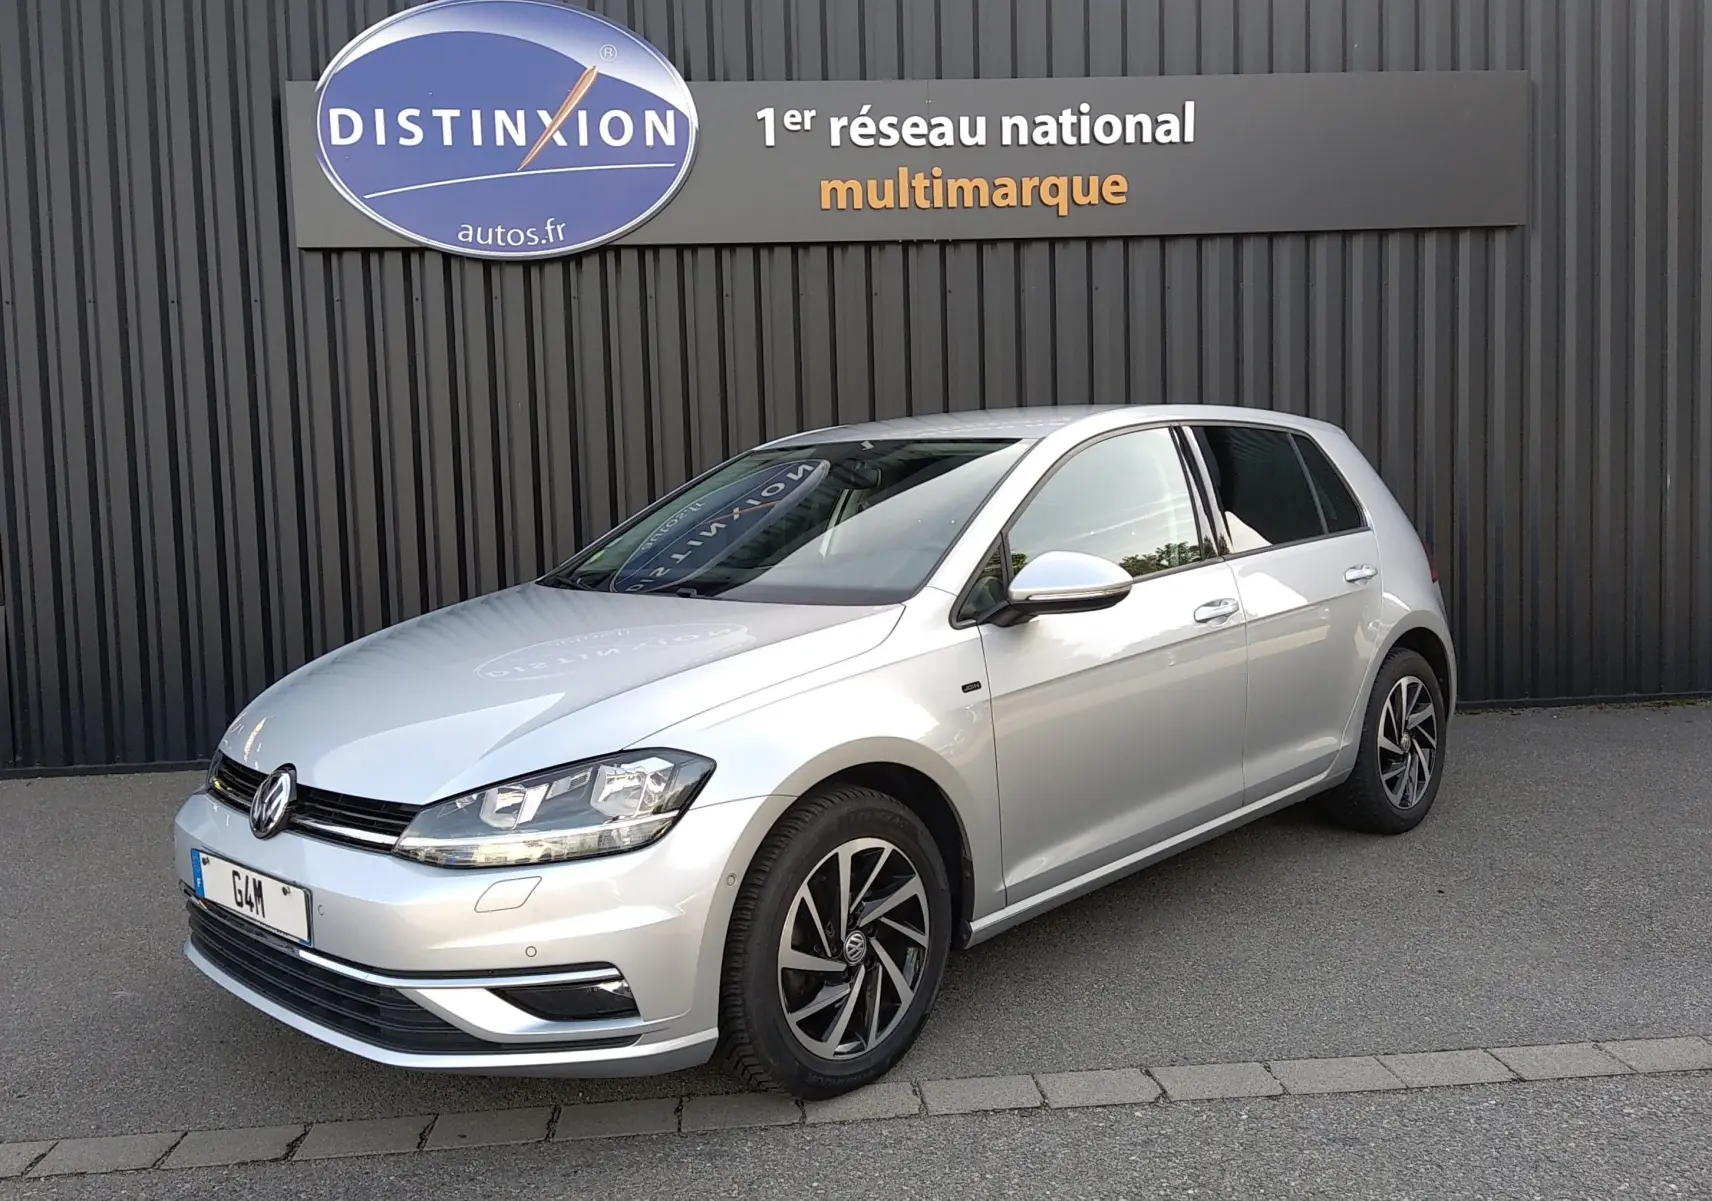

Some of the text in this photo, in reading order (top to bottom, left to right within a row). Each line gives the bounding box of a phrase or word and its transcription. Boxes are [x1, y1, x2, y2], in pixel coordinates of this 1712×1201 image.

[328, 107, 676, 148] DISTINXION
[756, 101, 1195, 147] 1er réseau national
[820, 167, 1129, 216] multimarque
[457, 218, 567, 248] autos.fr
[231, 869, 266, 918] G4M
